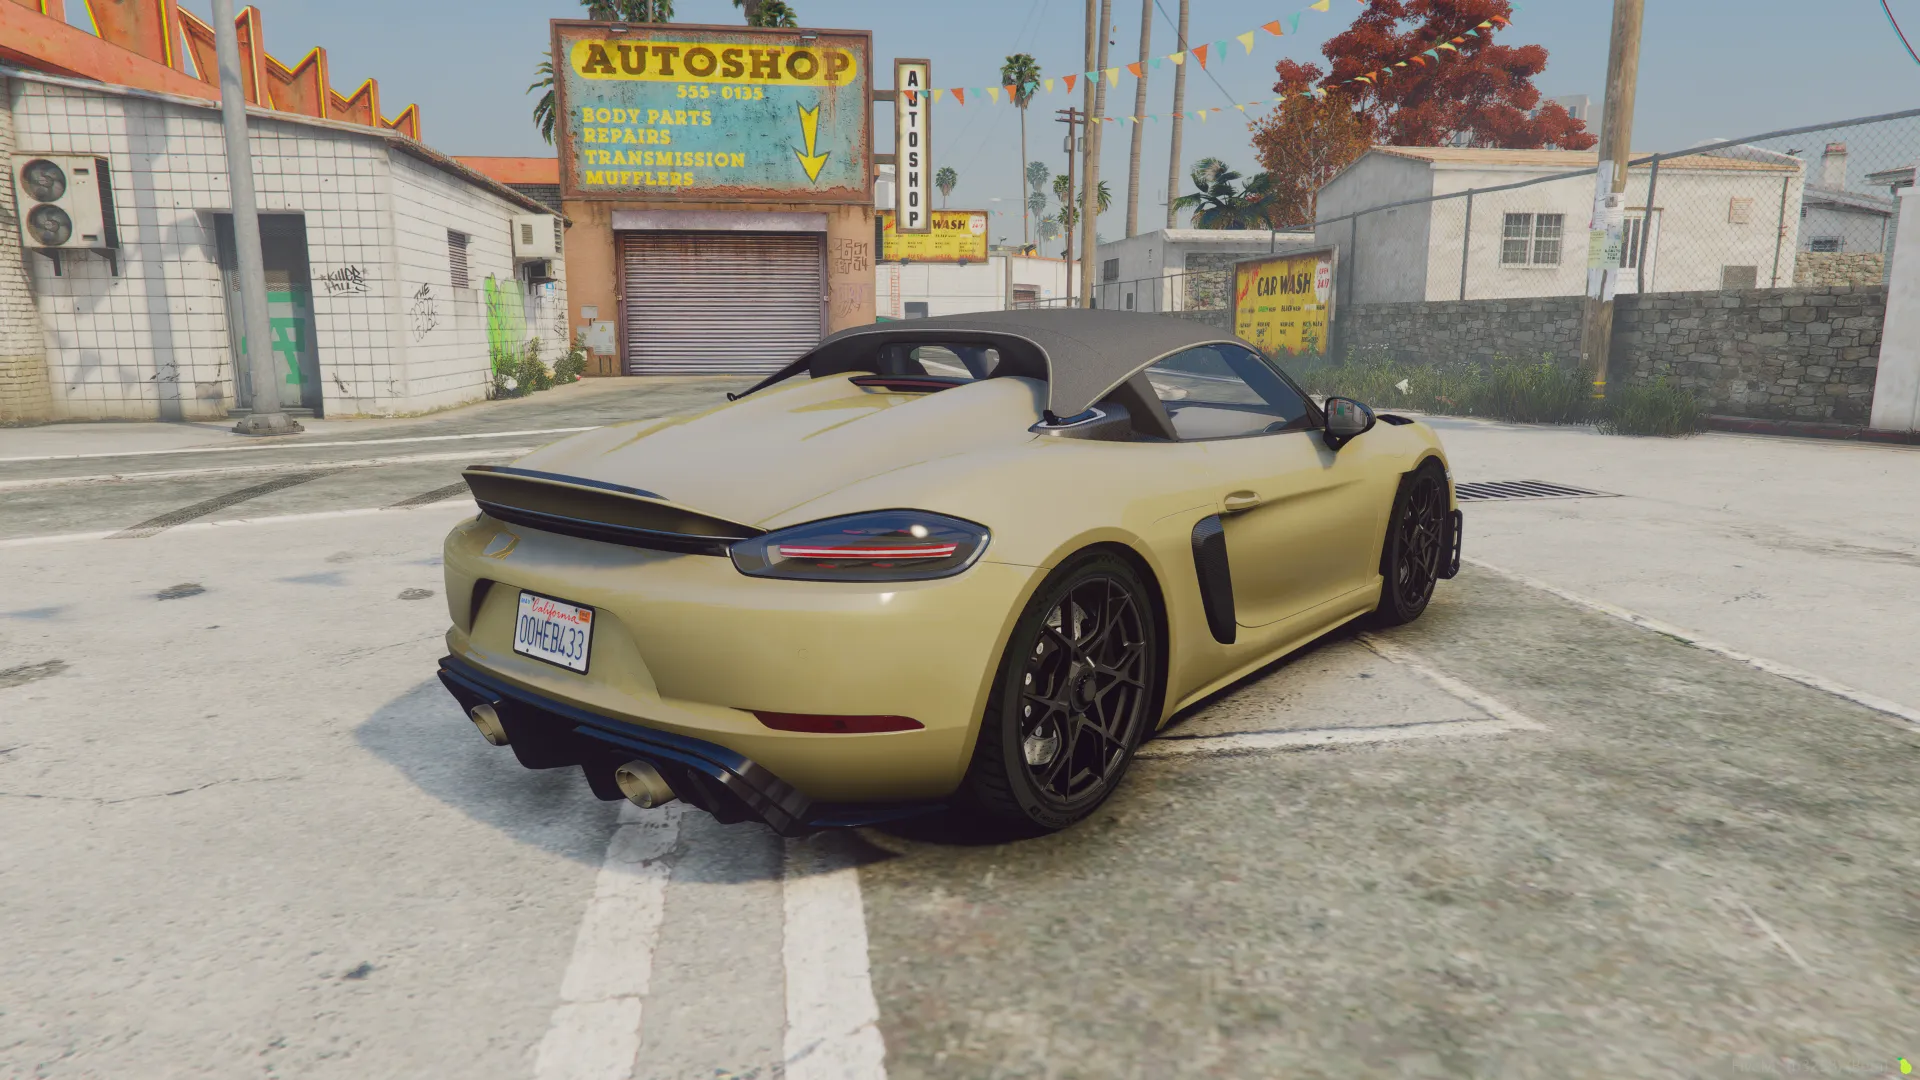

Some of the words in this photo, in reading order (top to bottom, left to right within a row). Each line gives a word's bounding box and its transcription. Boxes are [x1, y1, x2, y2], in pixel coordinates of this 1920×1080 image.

[581, 43, 850, 81] AUTOSHOP
[582, 107, 640, 125] BODY
[647, 109, 712, 127] PARTS
[583, 128, 671, 145] REPAIRS
[584, 149, 745, 168] TRANSMISSION
[586, 170, 694, 187] MUFFLERS
[932, 219, 966, 230] WASH
[1257, 275, 1278, 297] CAR
[1280, 272, 1312, 295] WASH
[532, 598, 580, 625] California
[520, 614, 584, 660] 00HEB433
